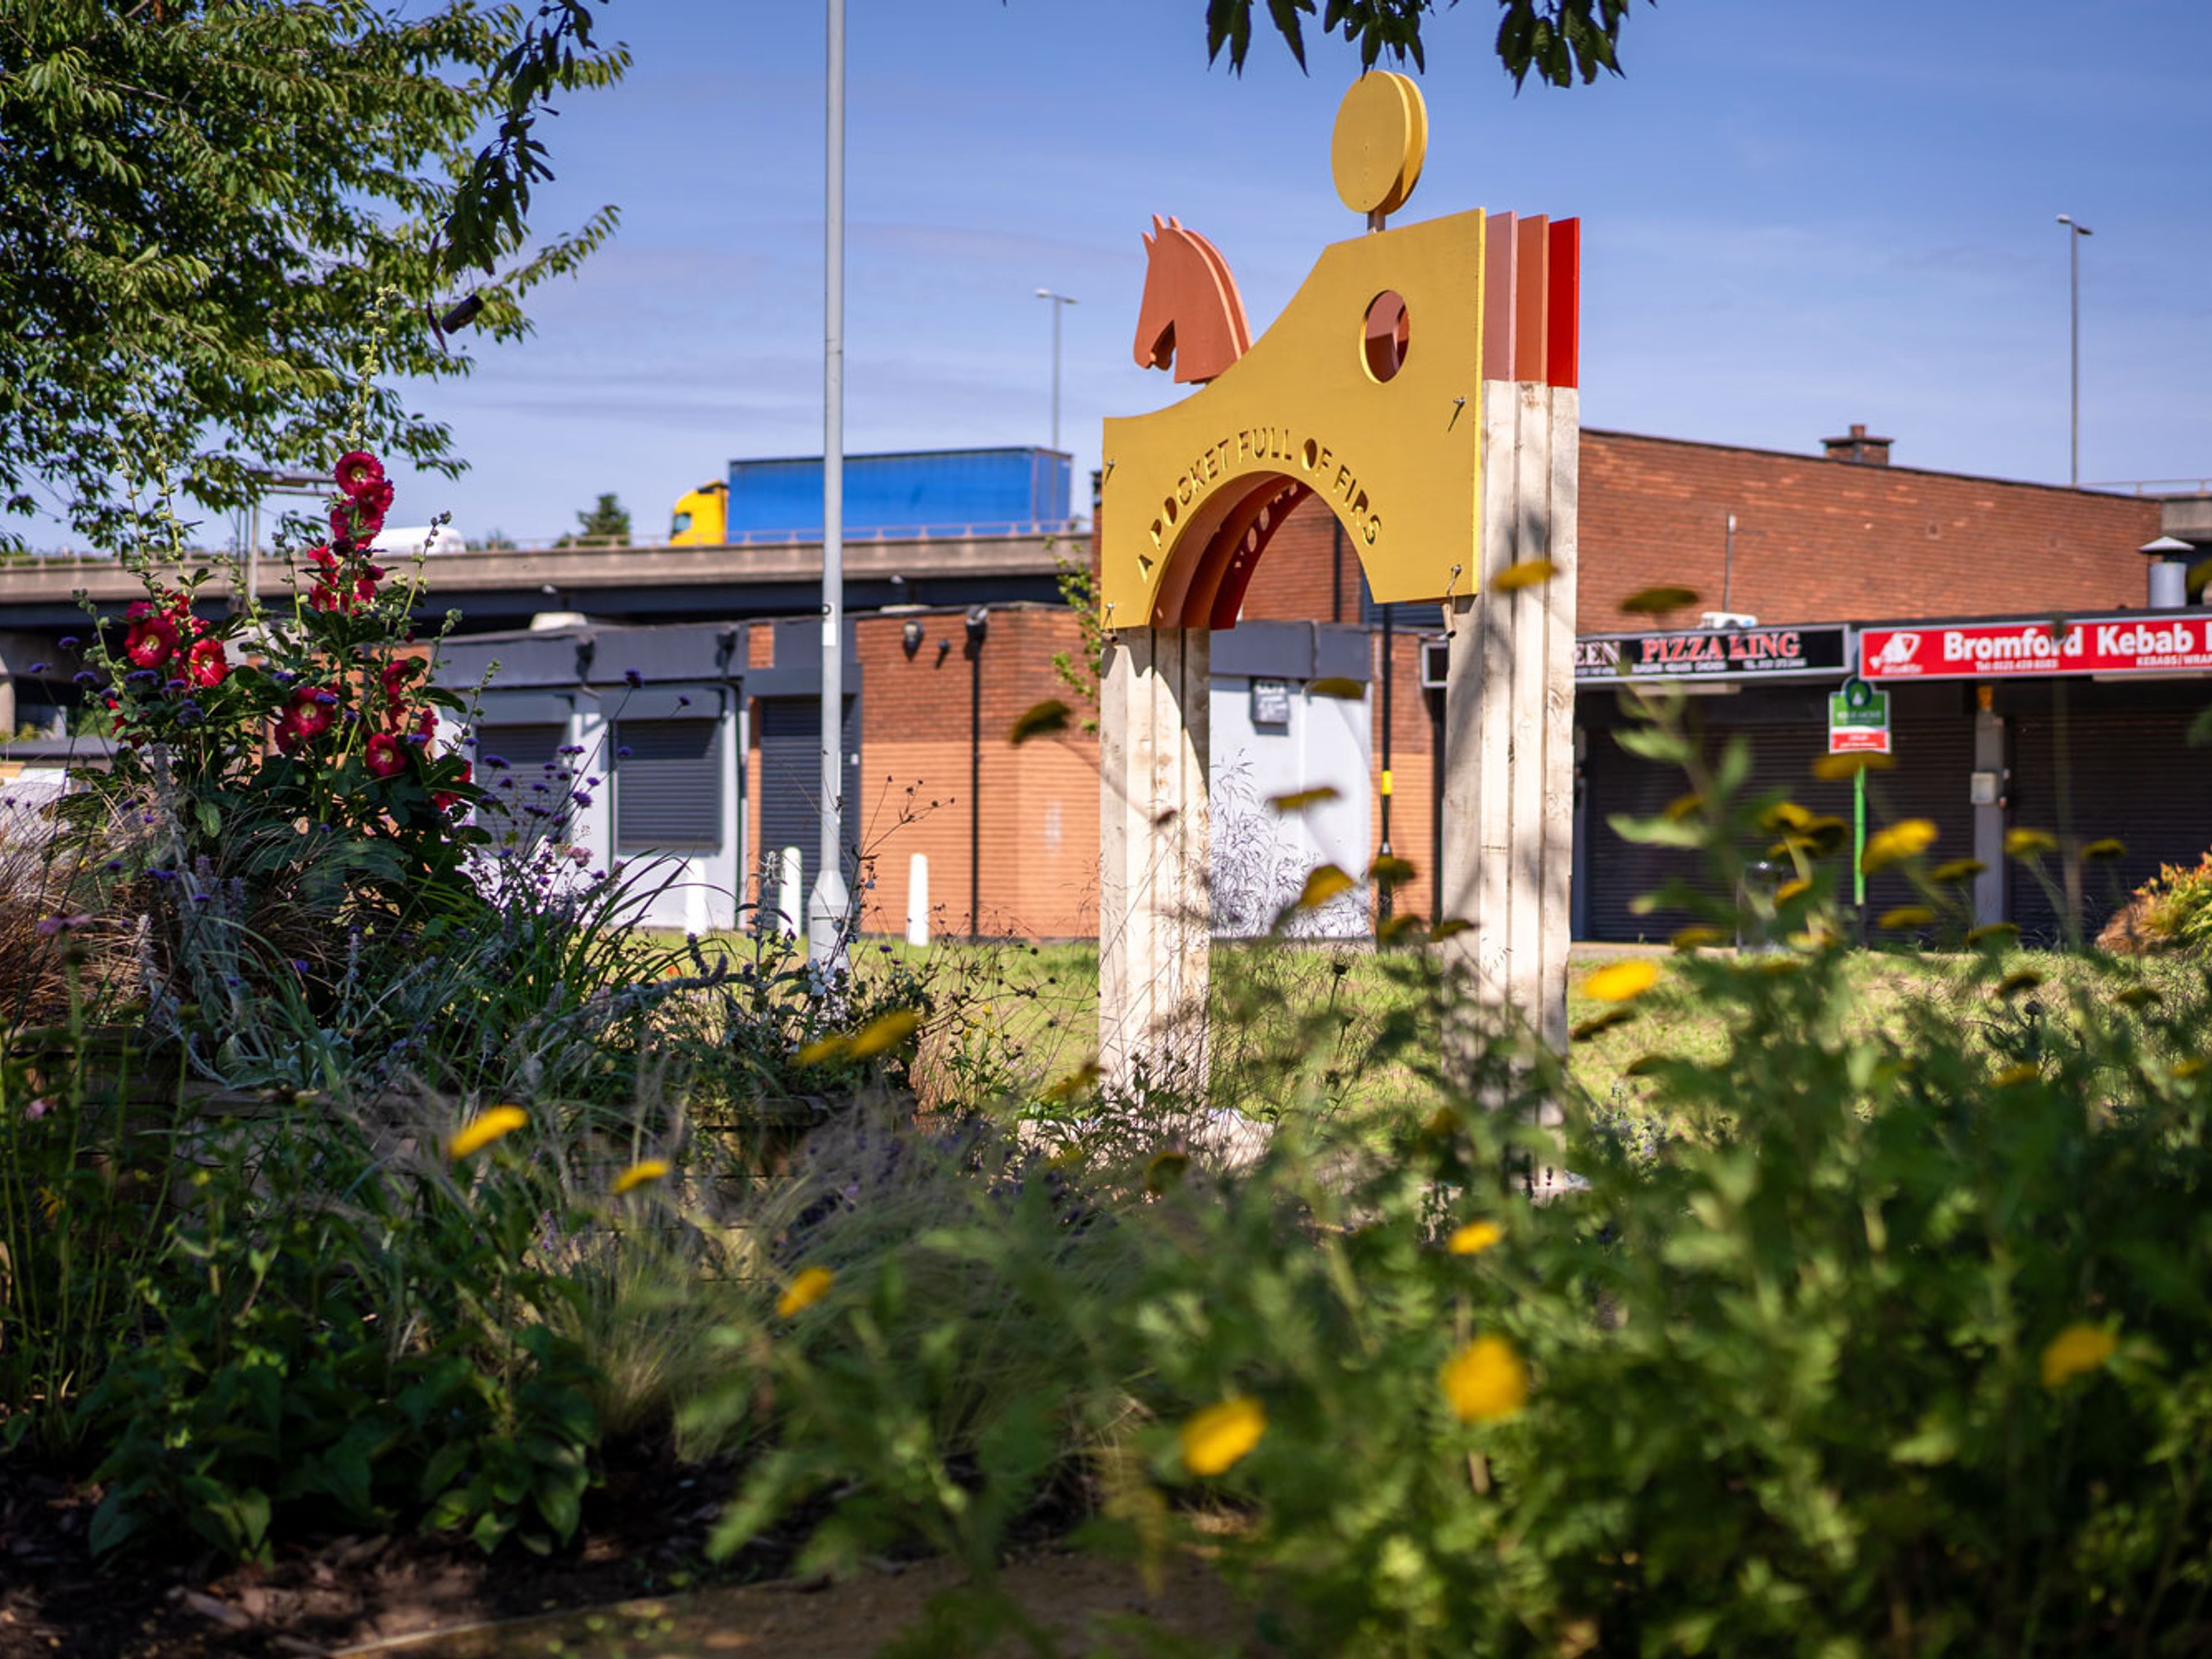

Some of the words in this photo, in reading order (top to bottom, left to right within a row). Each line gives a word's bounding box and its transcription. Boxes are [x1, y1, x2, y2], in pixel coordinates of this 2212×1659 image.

[1137, 554, 1154, 584] A
[1150, 439, 1229, 551] POCKET
[1238, 427, 1292, 464] FULL
[1301, 438, 1333, 477] OF
[1333, 464, 1382, 547] FIRS
[1641, 635, 1726, 664] PIZZA
[1729, 632, 1801, 660] KING
[1943, 626, 2084, 661] Bromford
[2097, 623, 2195, 657] Kebab
